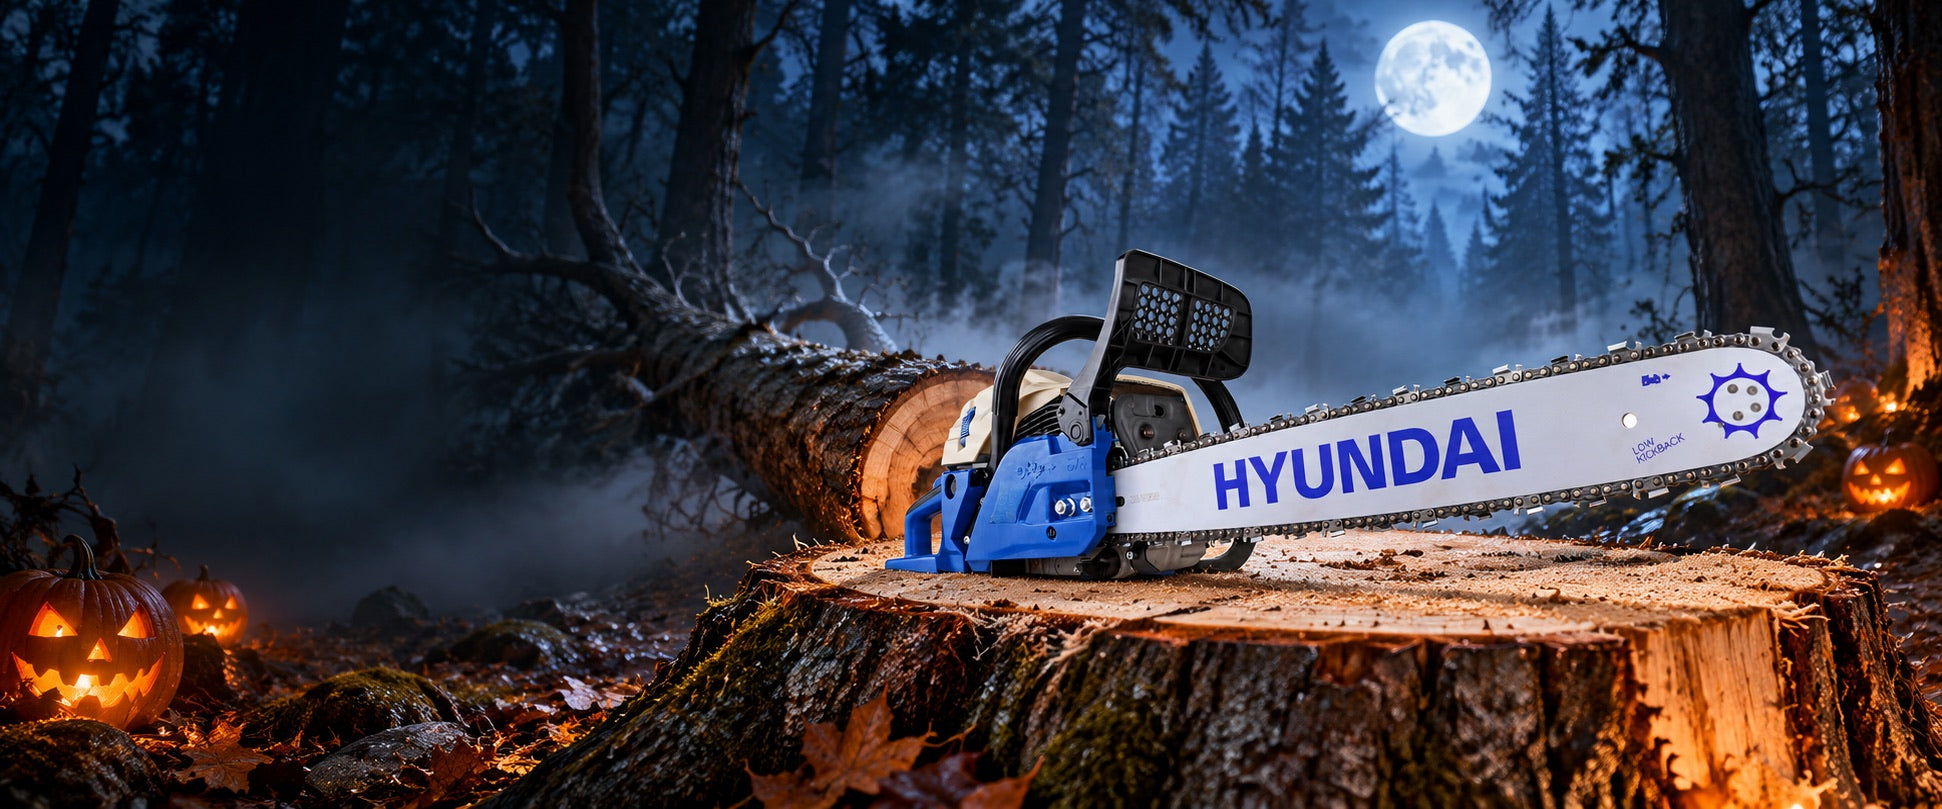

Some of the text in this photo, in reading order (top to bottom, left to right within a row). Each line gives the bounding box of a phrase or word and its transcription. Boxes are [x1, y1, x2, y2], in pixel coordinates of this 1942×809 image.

[1213, 410, 1521, 511] HYUNDAI
[1632, 437, 1655, 455] LOW
[1636, 433, 1685, 464] KICKBACK
